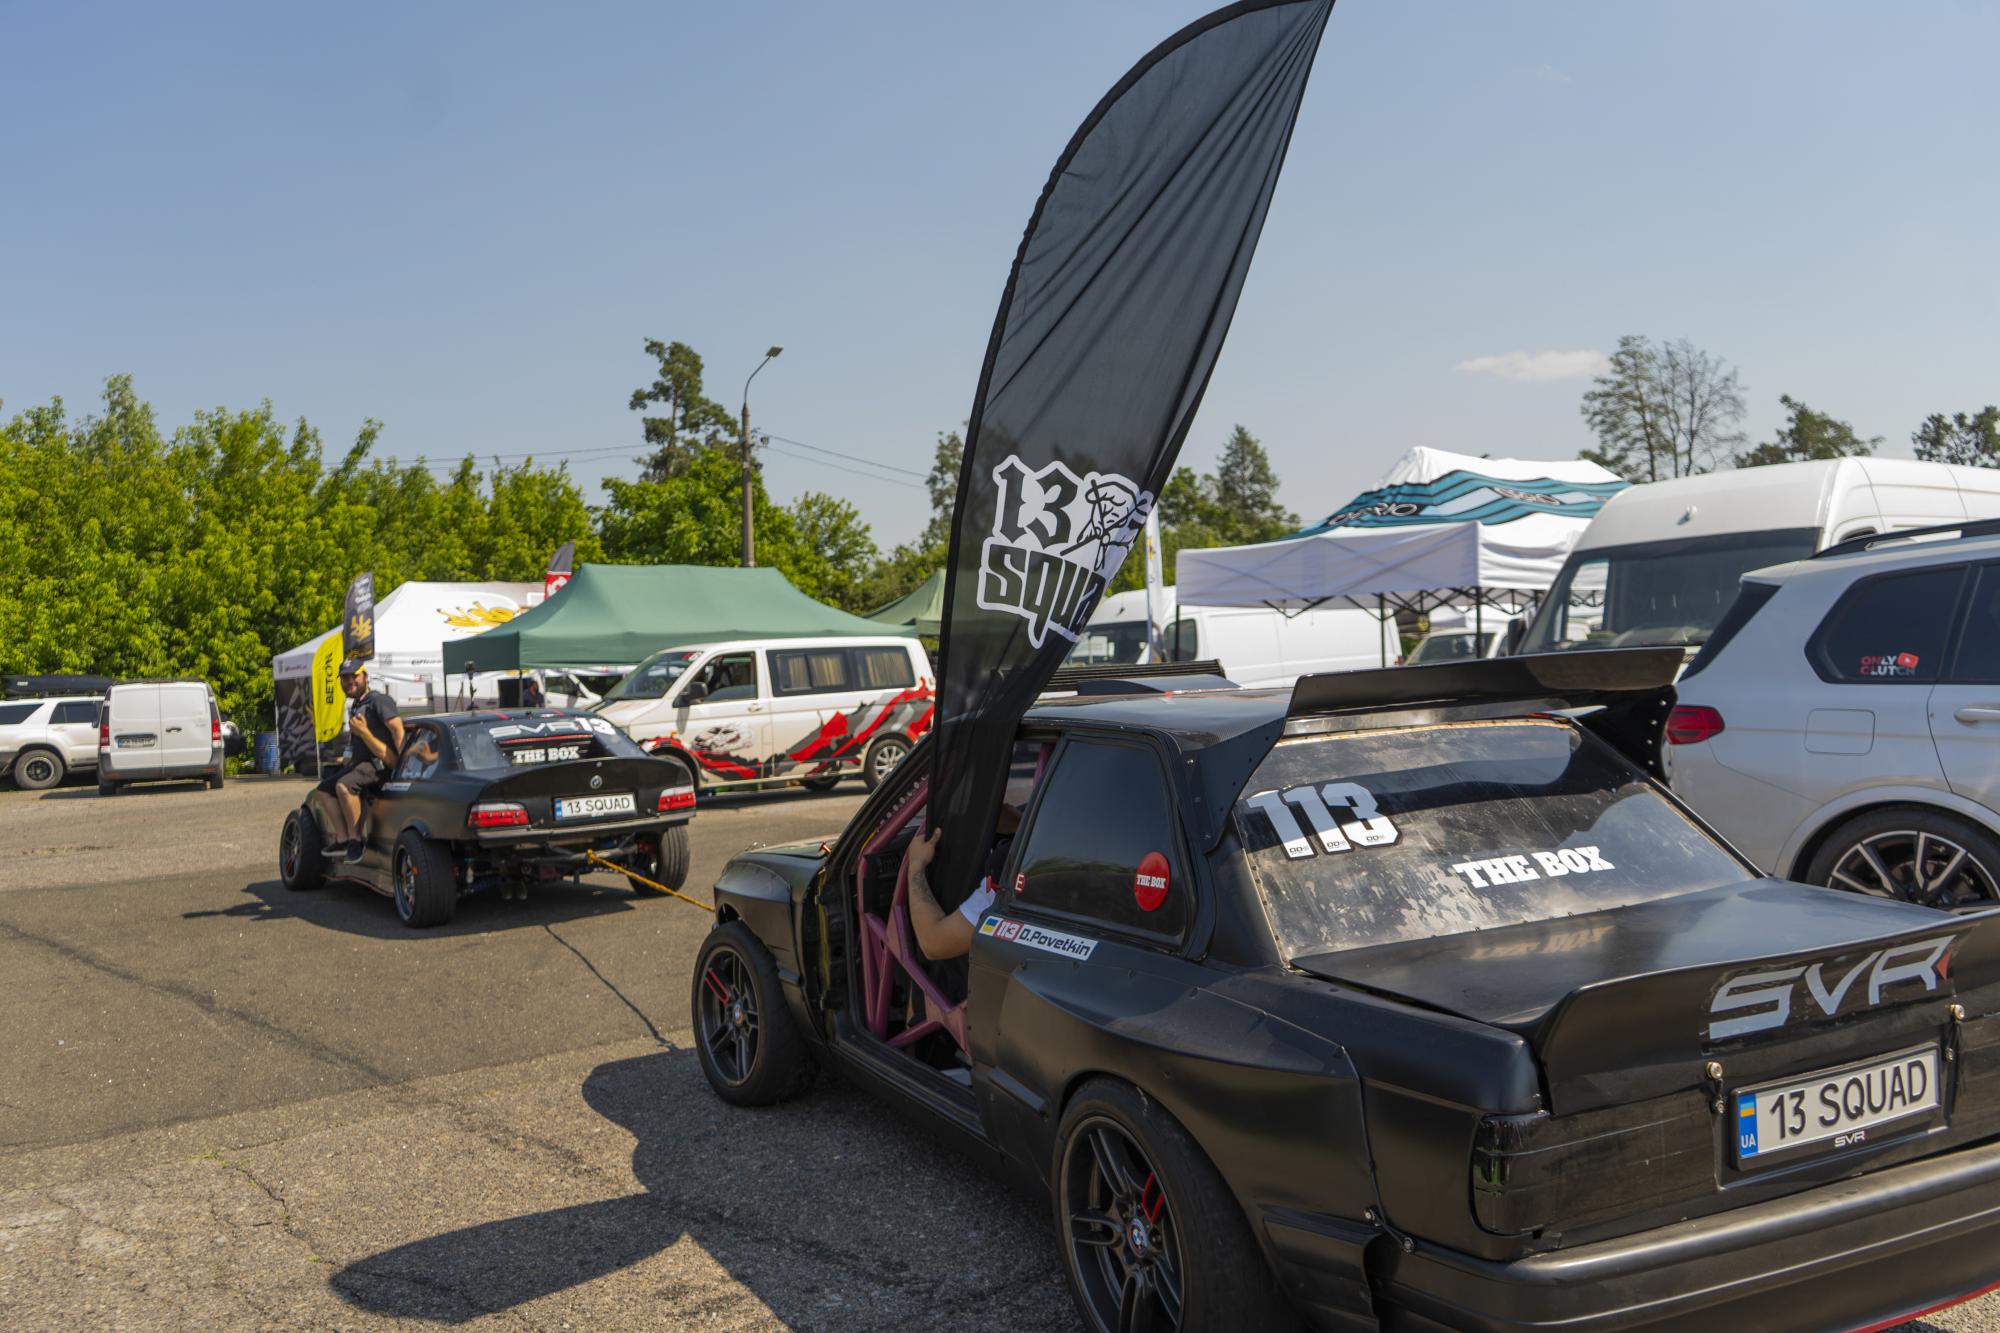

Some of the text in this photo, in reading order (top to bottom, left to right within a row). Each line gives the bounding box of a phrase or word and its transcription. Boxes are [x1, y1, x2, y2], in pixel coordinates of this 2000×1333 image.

[994, 455, 1082, 550] 13
[325, 652, 334, 704] BETON
[575, 717, 617, 735] 13
[513, 745, 579, 764] THE BOX
[567, 797, 630, 814] 13 SQUAD
[1245, 781, 1399, 859] 113
[1137, 874, 1166, 888] THE BOX
[1453, 846, 1615, 888] THE BOX
[1709, 935, 1956, 1040] SVR
[1769, 1059, 1927, 1139] 13 SQUAD
[1741, 1133, 1756, 1149] UA
[1834, 1130, 1865, 1148] SVR
